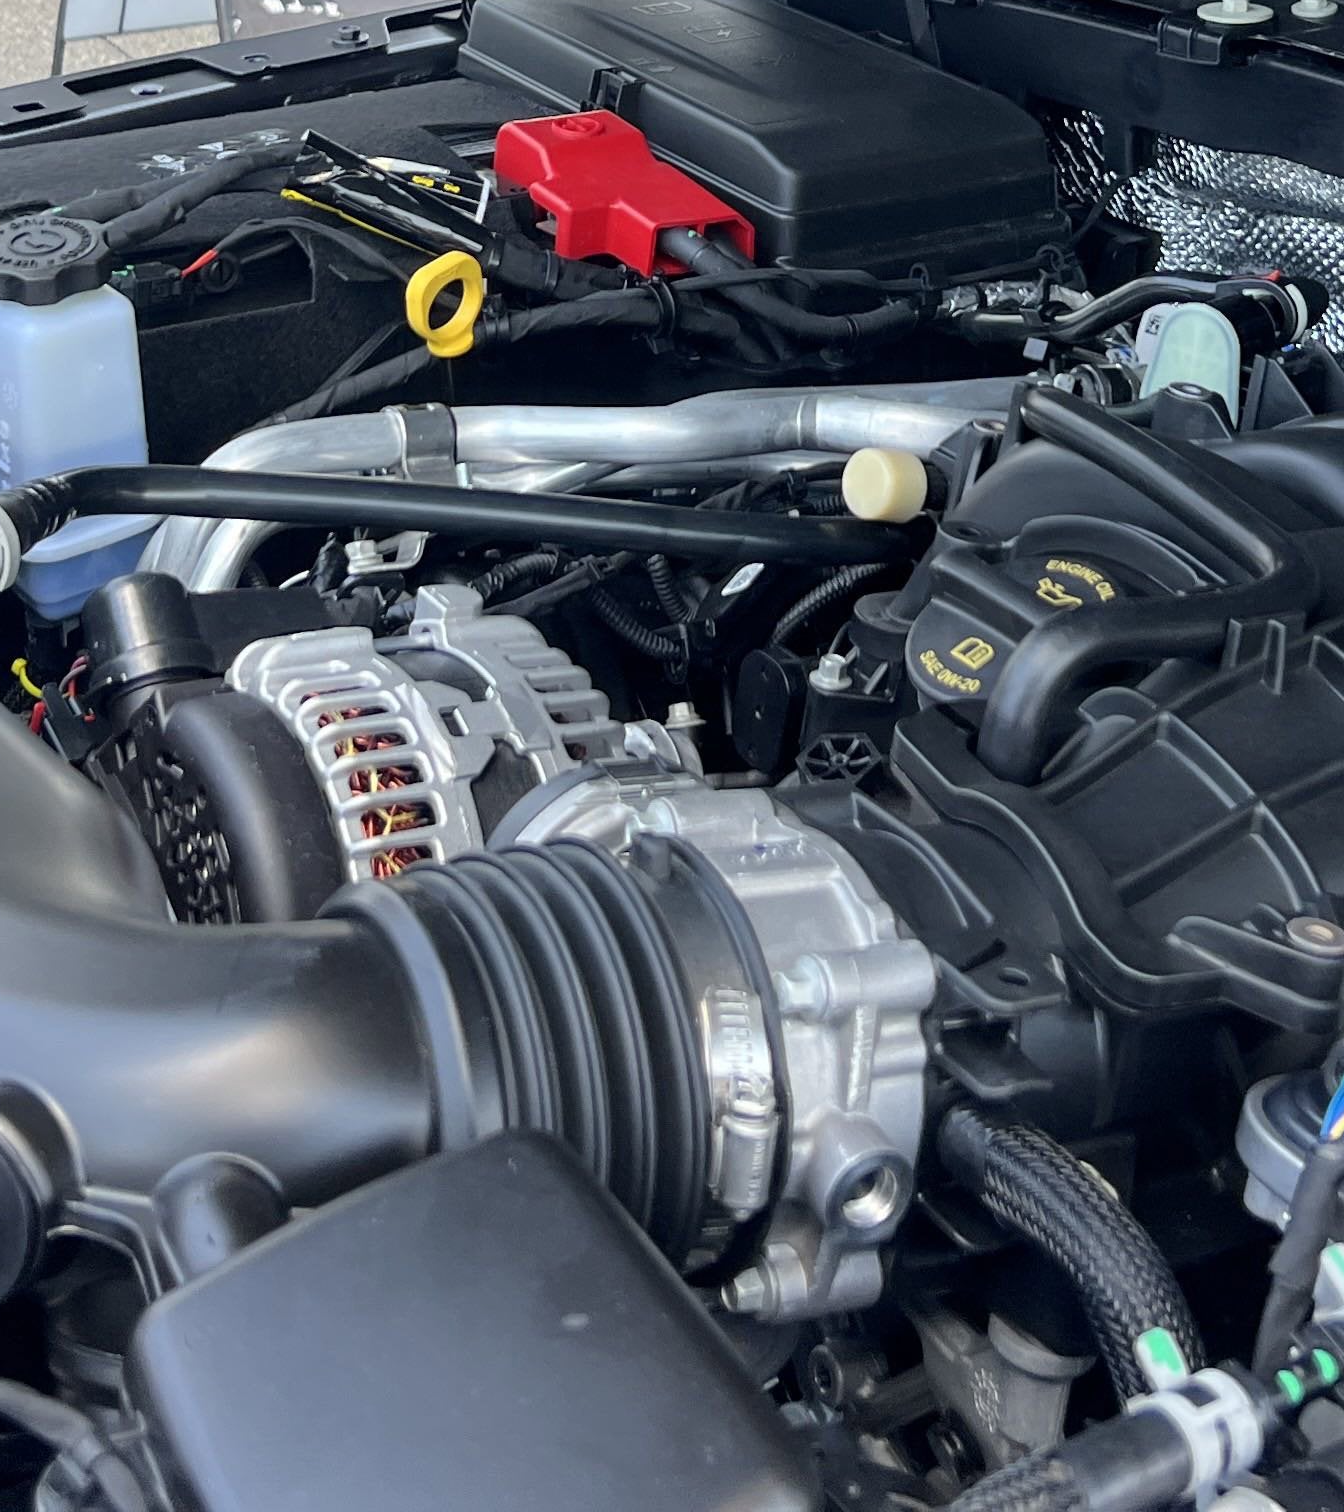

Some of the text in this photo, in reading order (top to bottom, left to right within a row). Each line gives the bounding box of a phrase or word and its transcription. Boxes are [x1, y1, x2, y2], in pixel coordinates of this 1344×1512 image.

[1045, 559, 1117, 603] ENGINE OIL
[918, 648, 982, 695] SAE 0W-20
